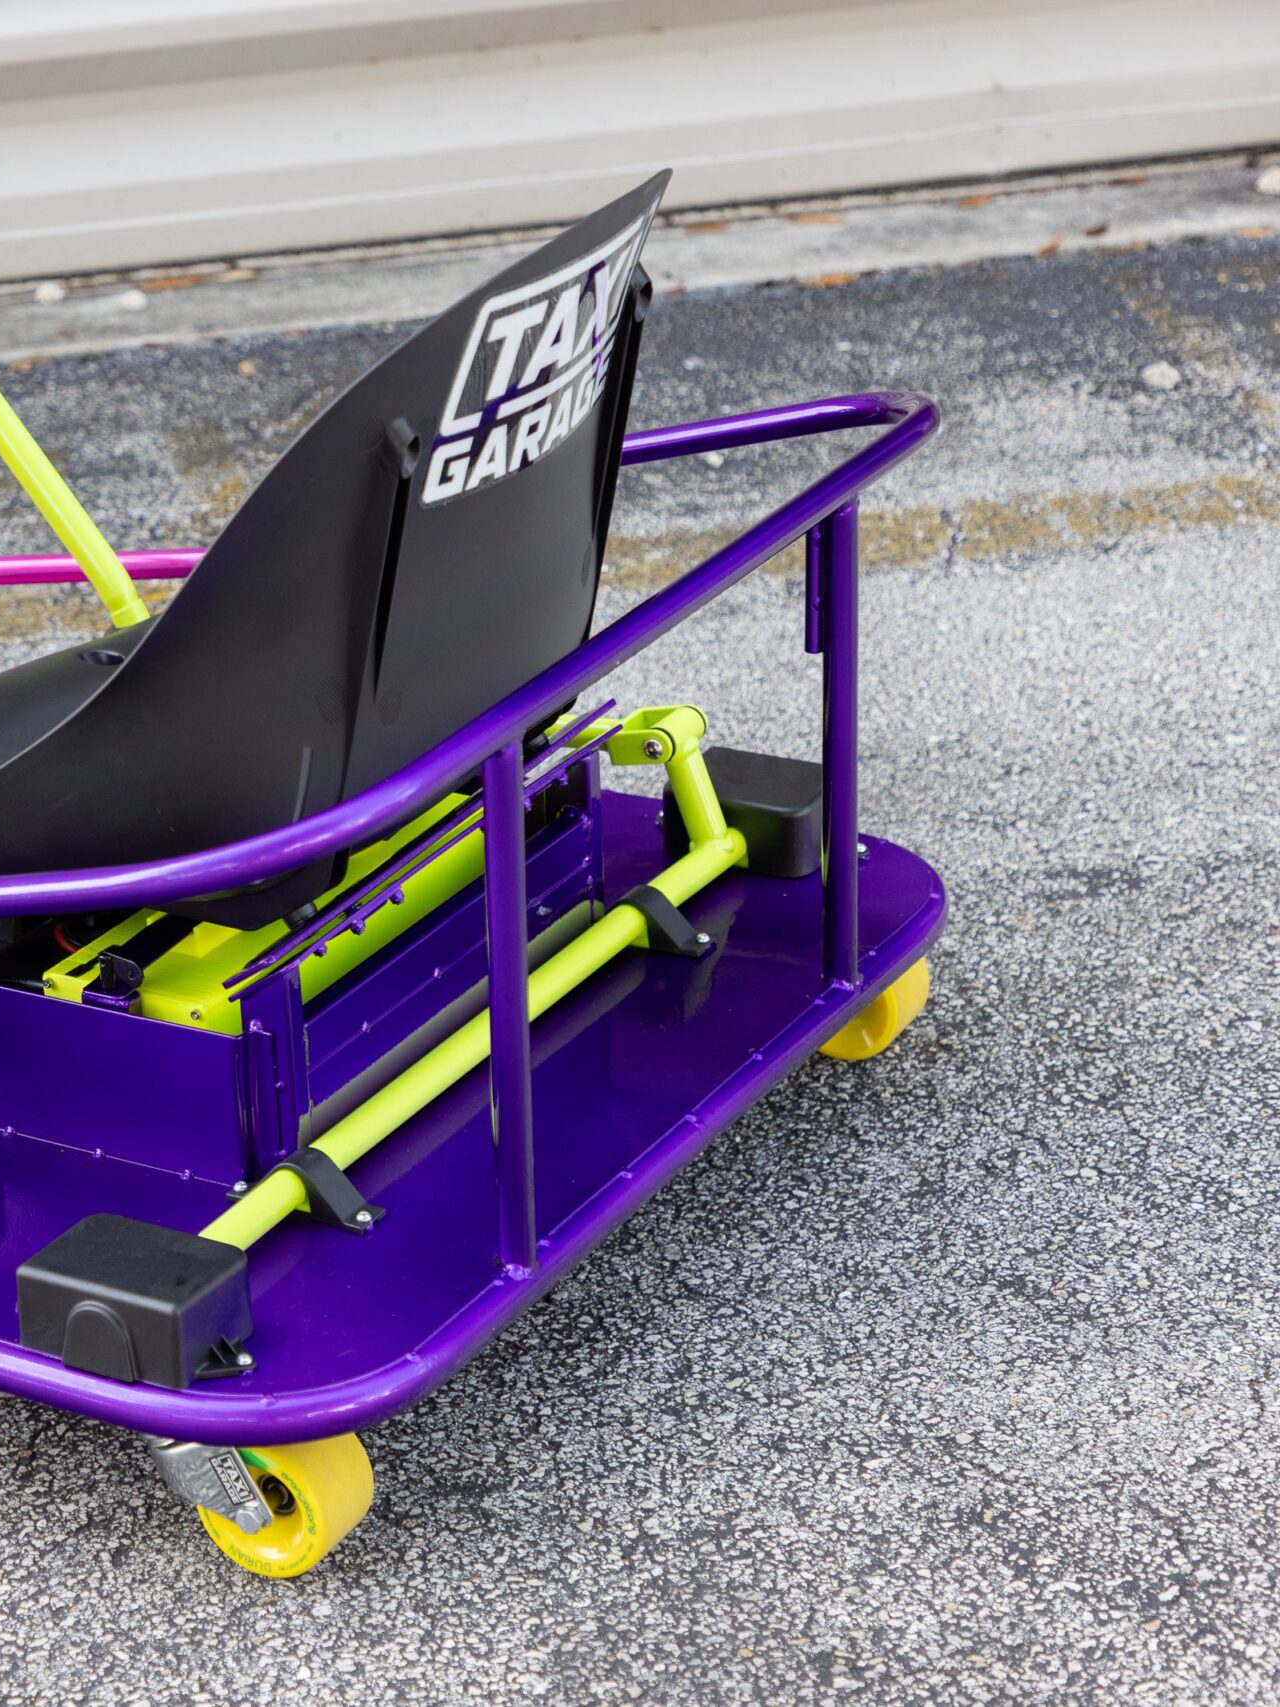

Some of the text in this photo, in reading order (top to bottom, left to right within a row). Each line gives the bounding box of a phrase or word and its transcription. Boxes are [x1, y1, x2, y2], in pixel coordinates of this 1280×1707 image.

[486, 231, 643, 402] TAXI
[421, 336, 616, 505] GARAGE
[212, 1459, 240, 1504] GARAGE
[222, 1457, 249, 1499] TAXI
[228, 1544, 272, 1573] DURIAN
